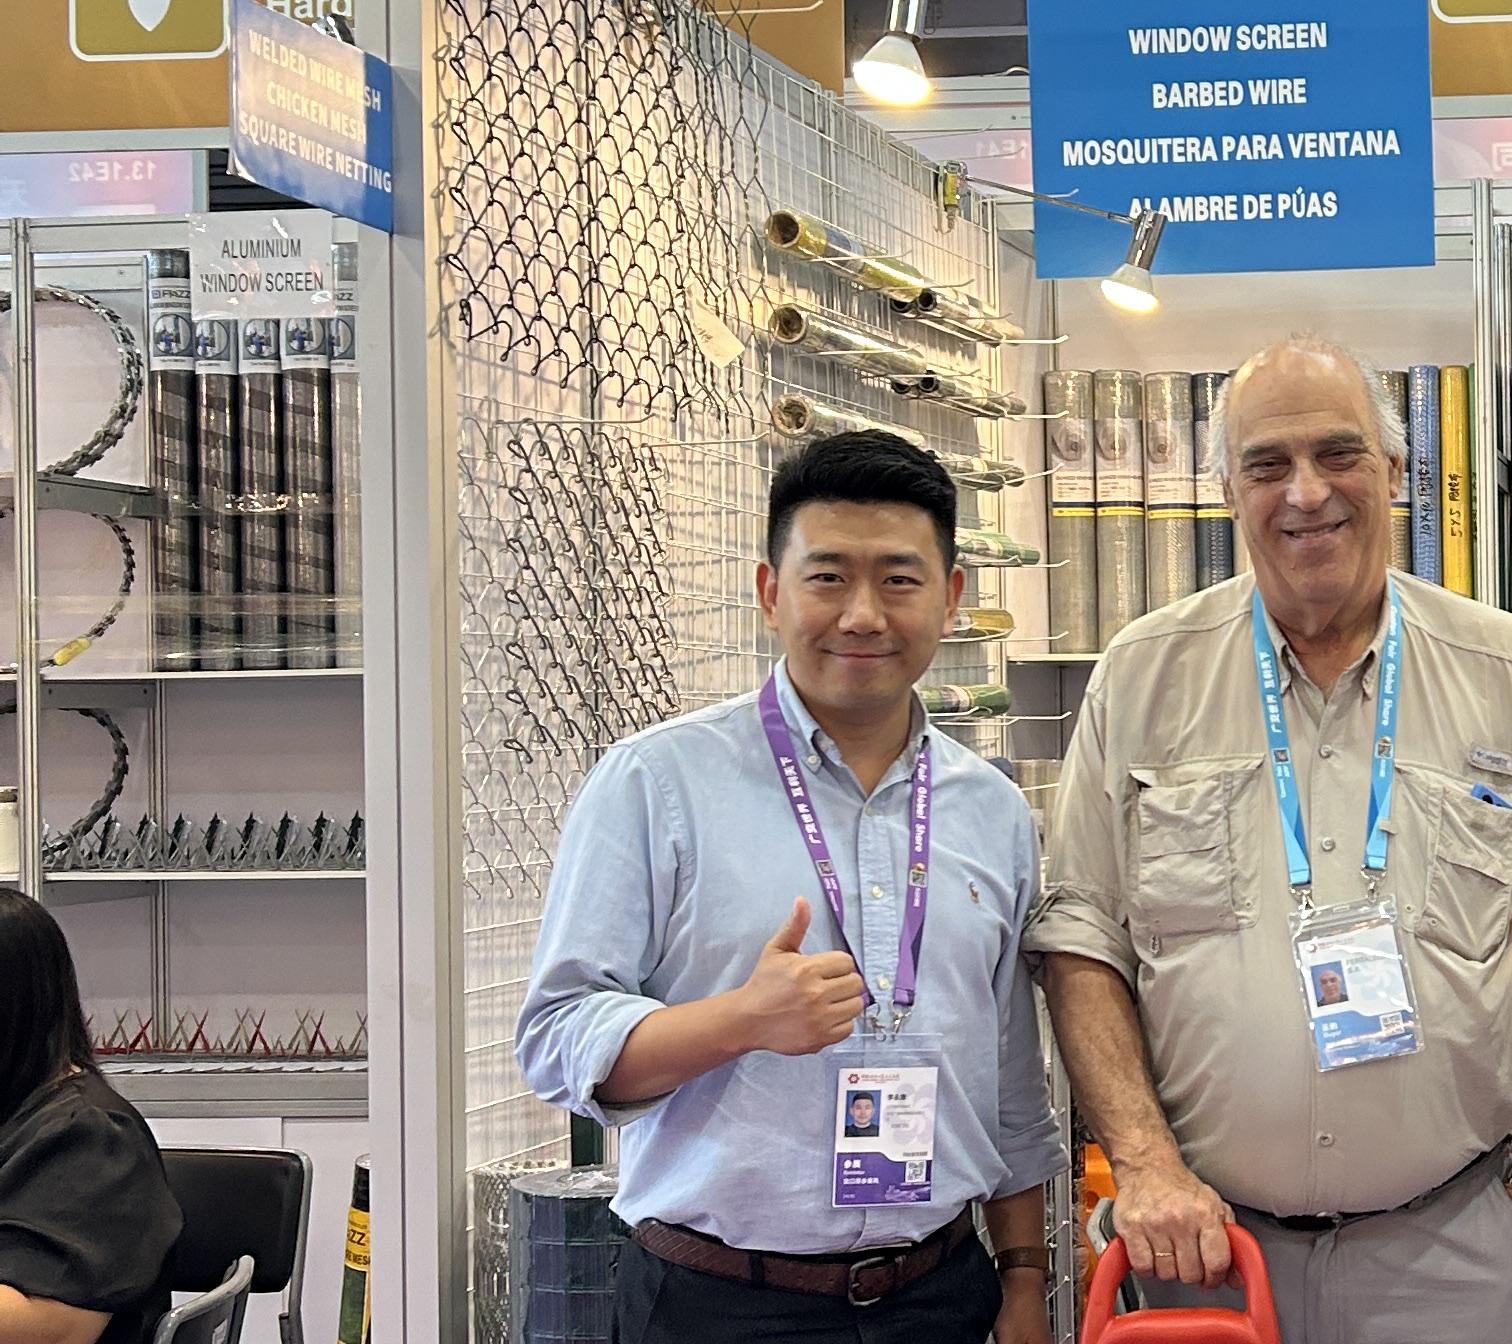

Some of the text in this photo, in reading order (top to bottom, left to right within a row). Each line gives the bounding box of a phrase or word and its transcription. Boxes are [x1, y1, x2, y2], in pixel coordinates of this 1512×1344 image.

[1128, 21, 1328, 55] WINDOW SCREEN
[249, 30, 381, 112] WELDED WIRE MESH
[1152, 77, 1307, 109] BARBED WIRE
[267, 80, 367, 144] CHICKEN MESH
[239, 110, 392, 193] SQUARE WIRE NETTING
[1062, 130, 1401, 167] MOSQUITERA PARA VENTANA
[1243, 193, 1273, 220] DE
[1277, 185, 1338, 219] PÚAS
[221, 239, 302, 259] ALUMINIUM
[200, 271, 323, 294] WINDOW SCREEN
[1383, 662, 1395, 694] Global
[1381, 698, 1392, 725] Share
[915, 786, 926, 819] Global
[914, 823, 925, 852] Share
